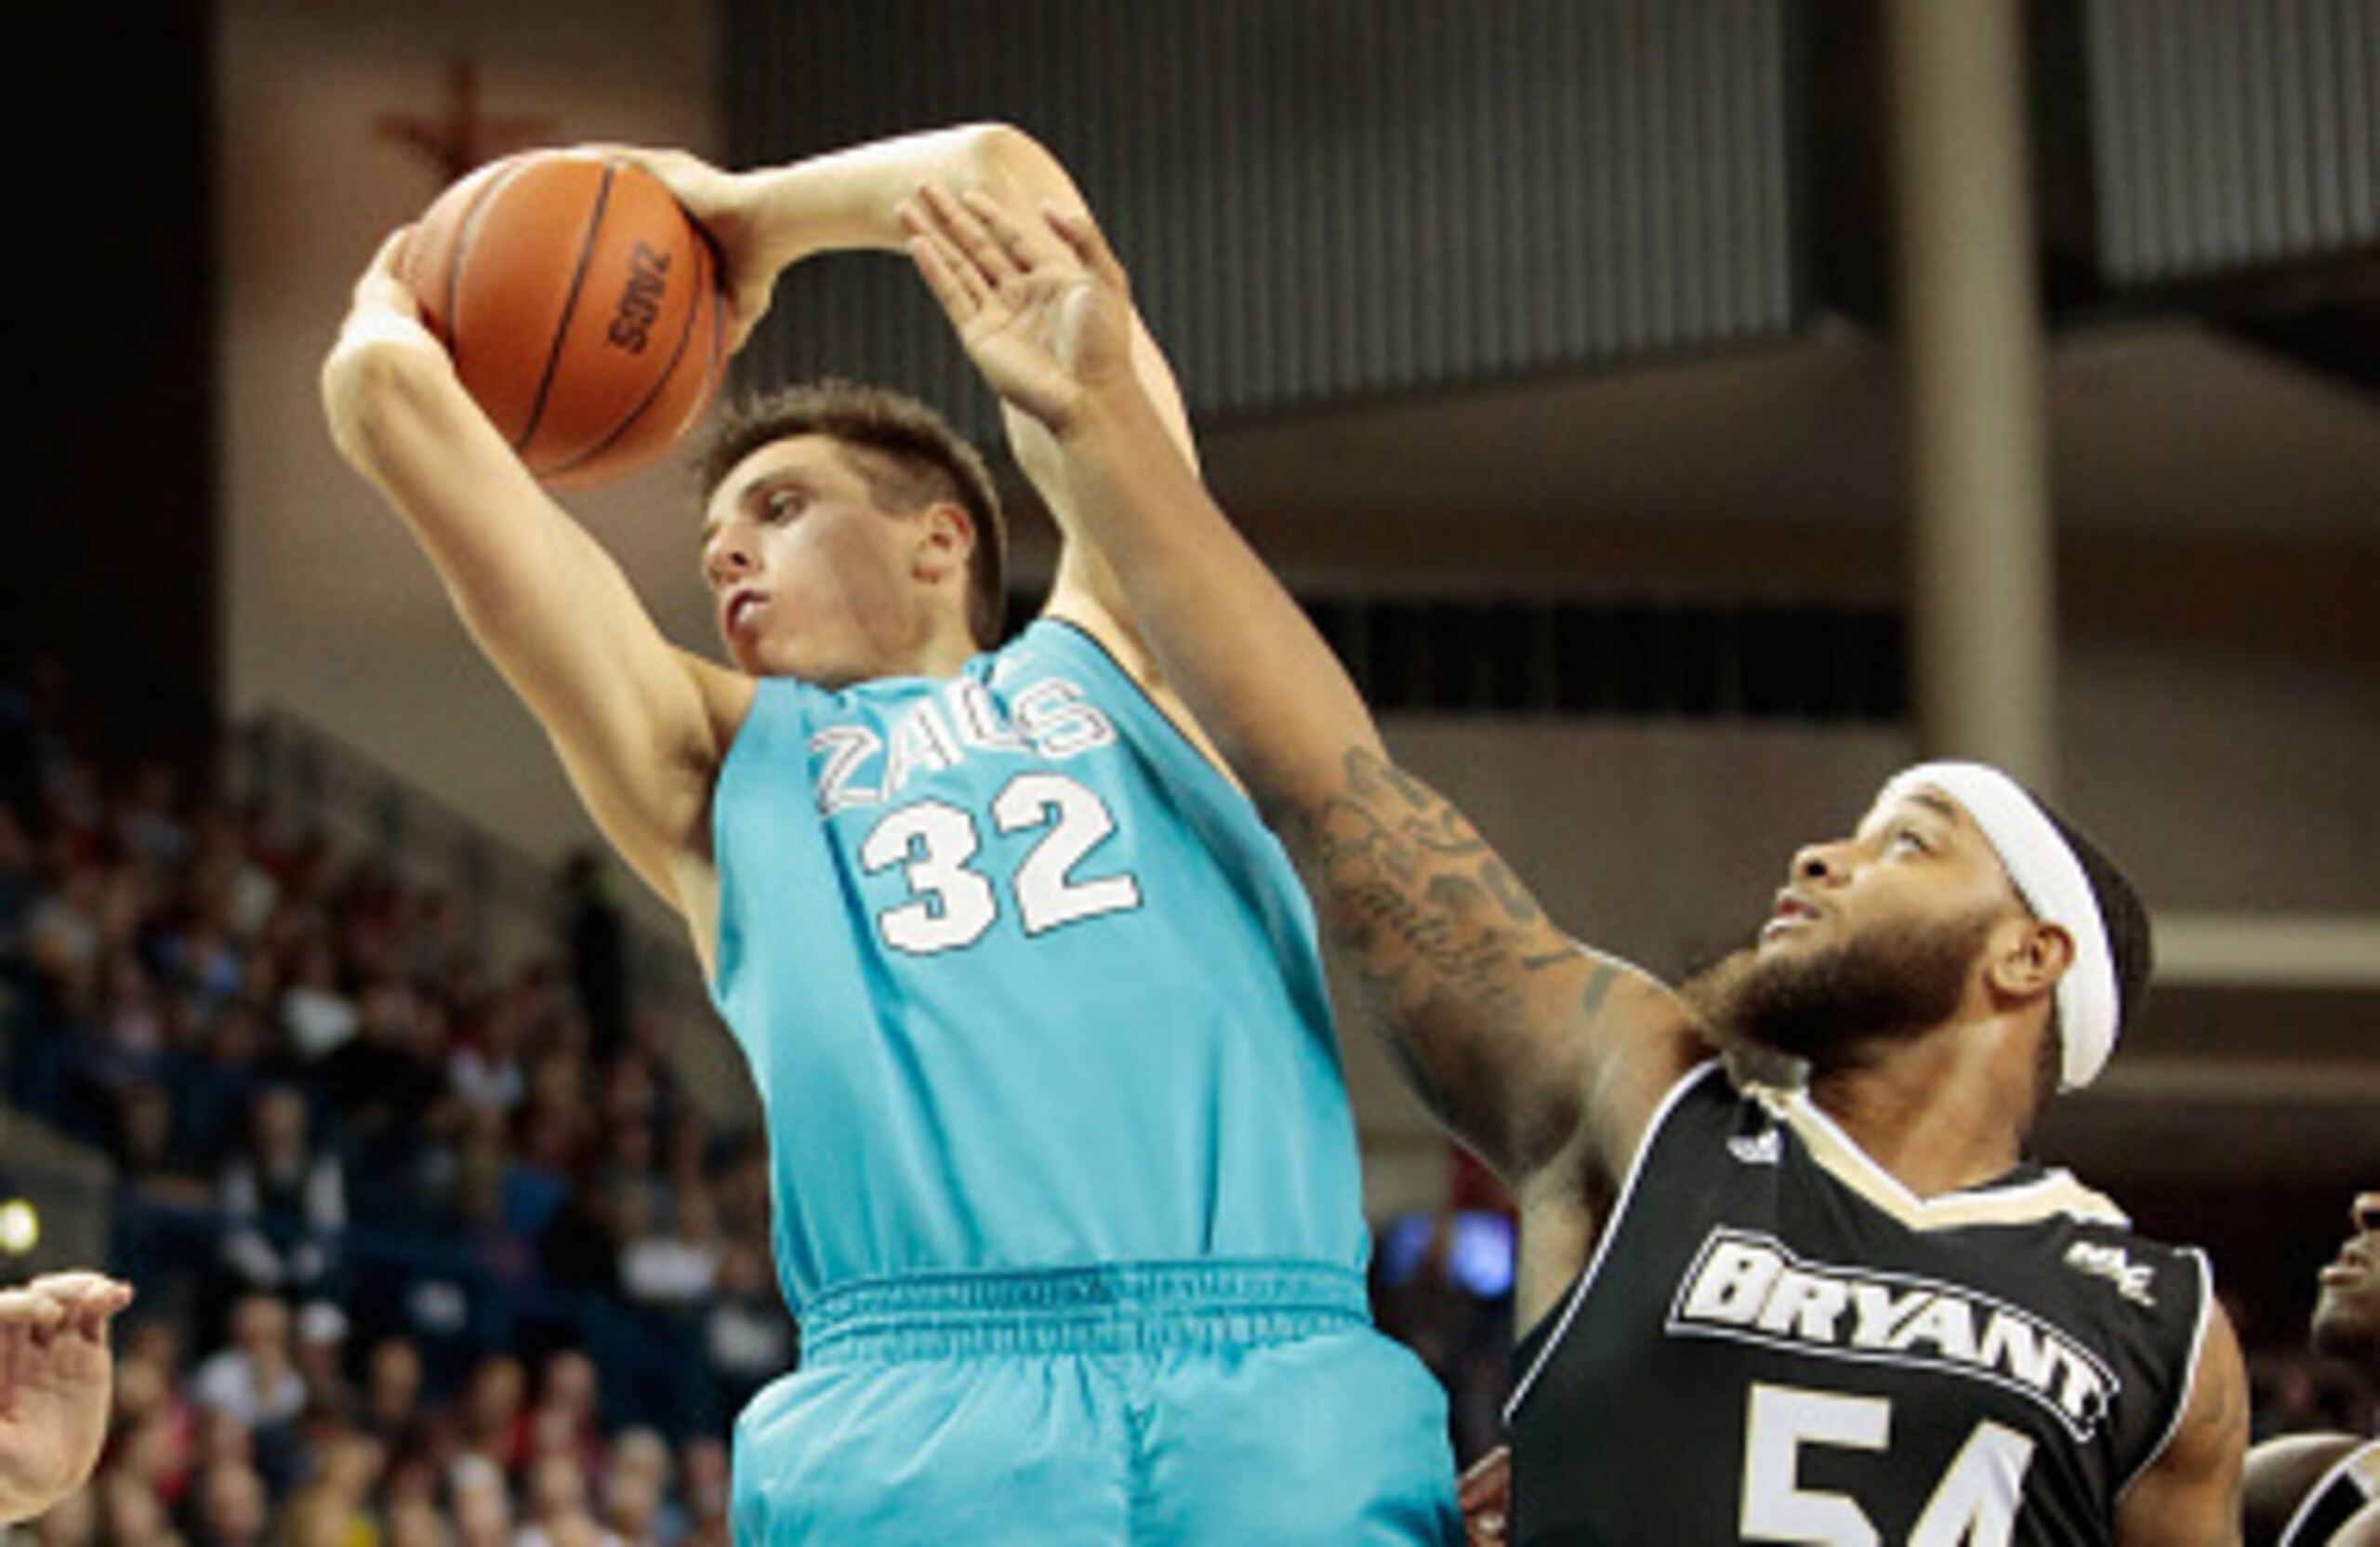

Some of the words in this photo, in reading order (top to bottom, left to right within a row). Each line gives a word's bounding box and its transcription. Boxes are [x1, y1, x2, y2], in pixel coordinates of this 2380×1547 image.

[606, 241, 671, 355] ZAGS
[858, 771, 1144, 959] 32
[1682, 1240, 2104, 1420] BRYANT
[1739, 1382, 2036, 1547] 54
